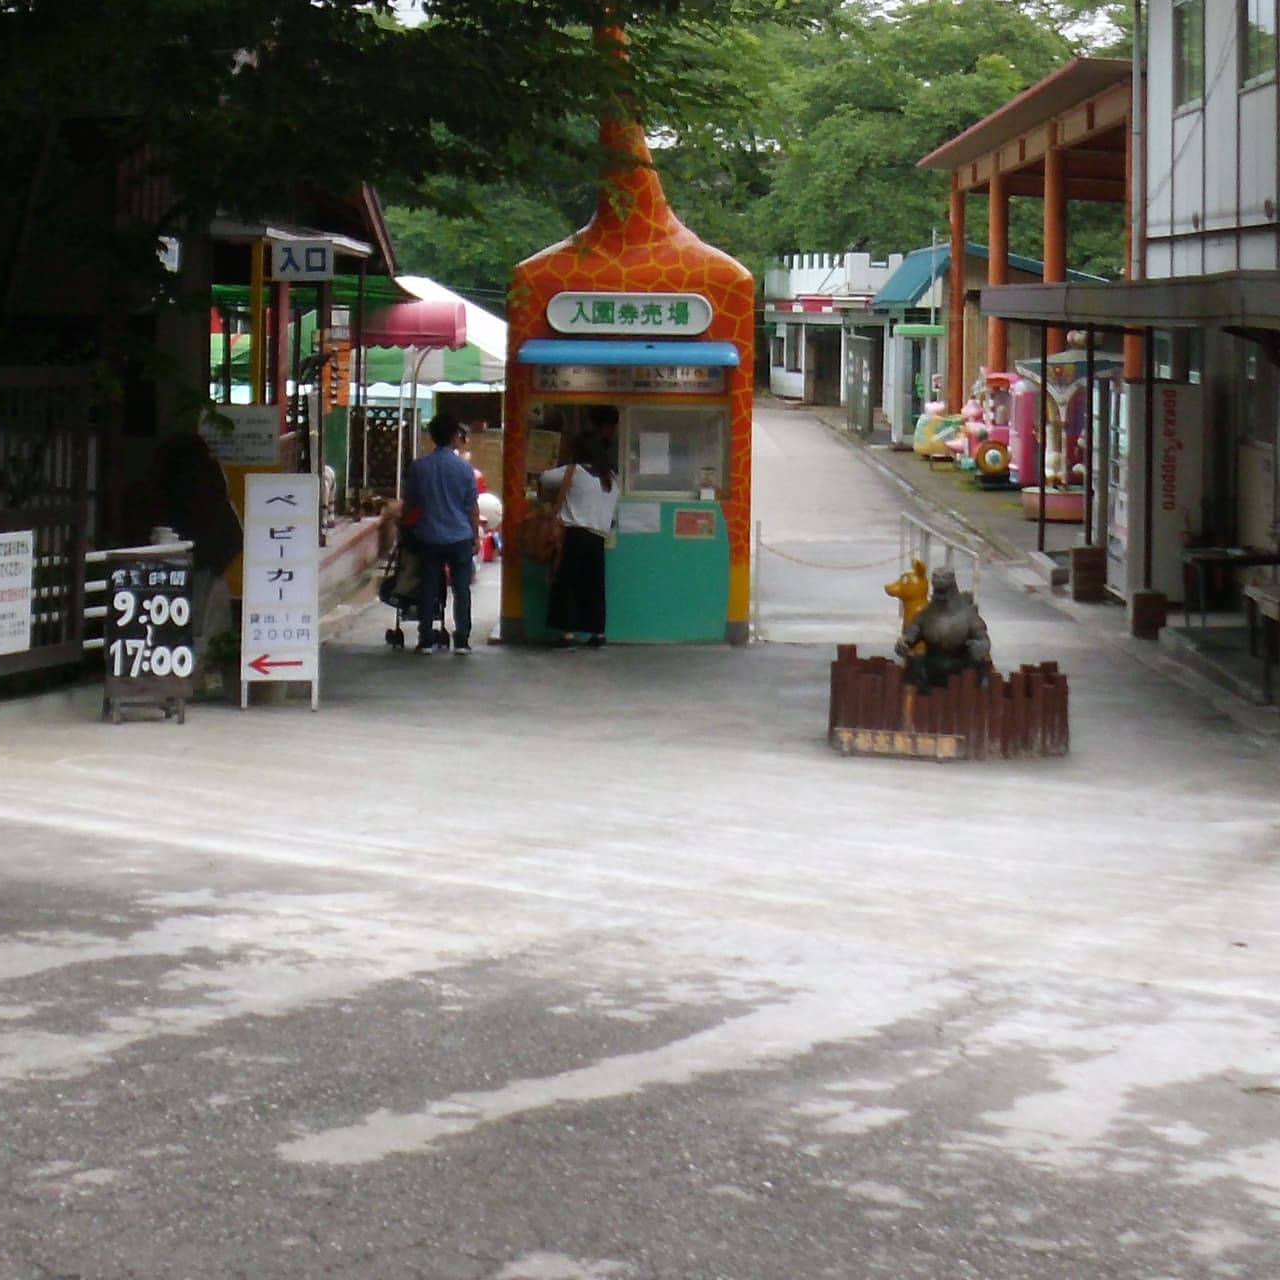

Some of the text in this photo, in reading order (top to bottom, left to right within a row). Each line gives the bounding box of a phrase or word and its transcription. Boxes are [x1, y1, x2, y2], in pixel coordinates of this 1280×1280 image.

[280, 247, 327, 272] 入口
[570, 301, 689, 326] 入園券売場
[265, 494, 299, 601] ベビーカー
[113, 591, 190, 627] 9:00
[110, 639, 193, 678] 17:00
